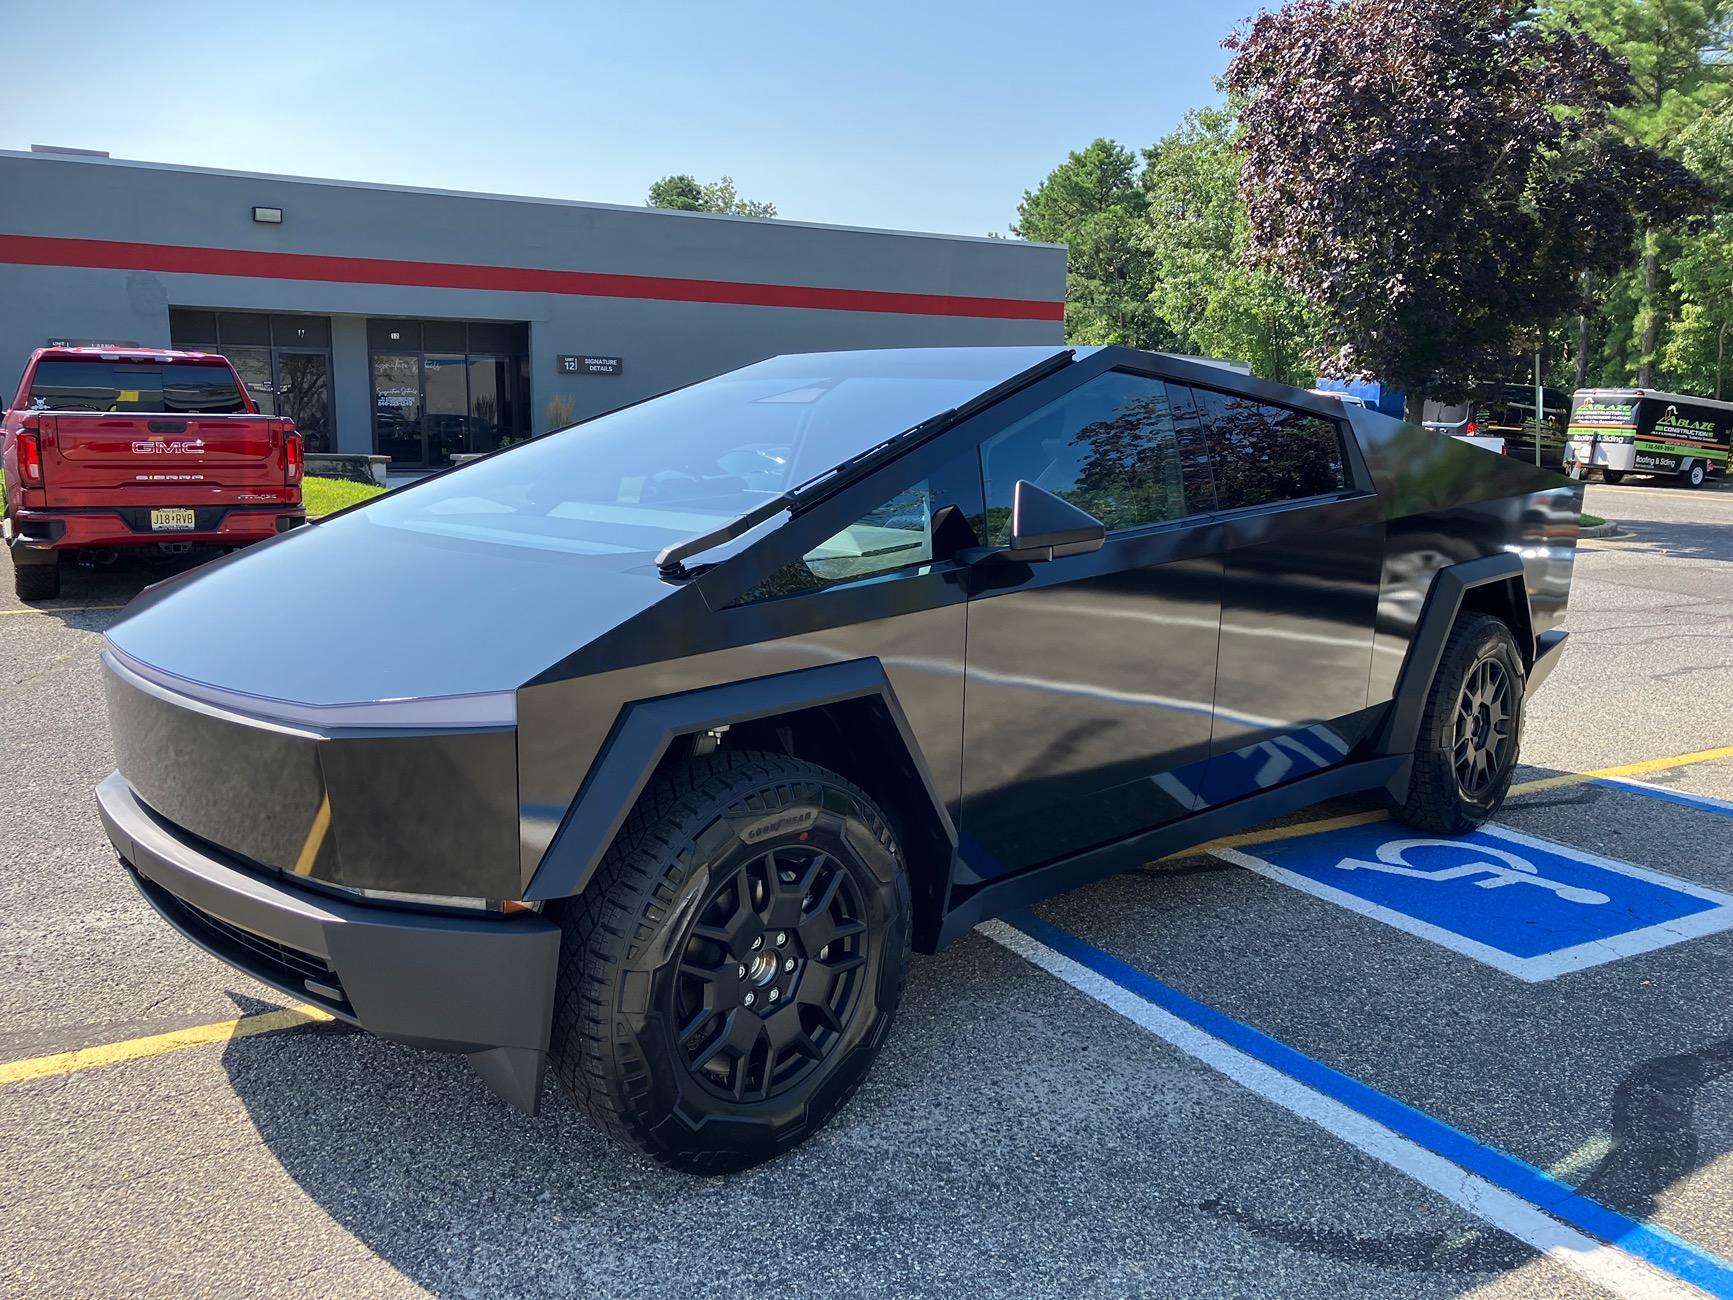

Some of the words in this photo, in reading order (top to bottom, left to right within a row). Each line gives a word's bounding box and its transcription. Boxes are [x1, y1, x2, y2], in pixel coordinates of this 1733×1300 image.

[564, 362, 575, 370] 12
[585, 358, 617, 366] SIGNATURE
[1656, 415, 1715, 431] ABLAZE
[1663, 426, 1708, 437] CONSTRUCTION
[1603, 435, 1624, 443] Siding
[132, 441, 205, 454] GMC
[1636, 455, 1655, 465] Roofing
[1660, 458, 1676, 468] Siding
[748, 811, 812, 839] GOODYEAR
